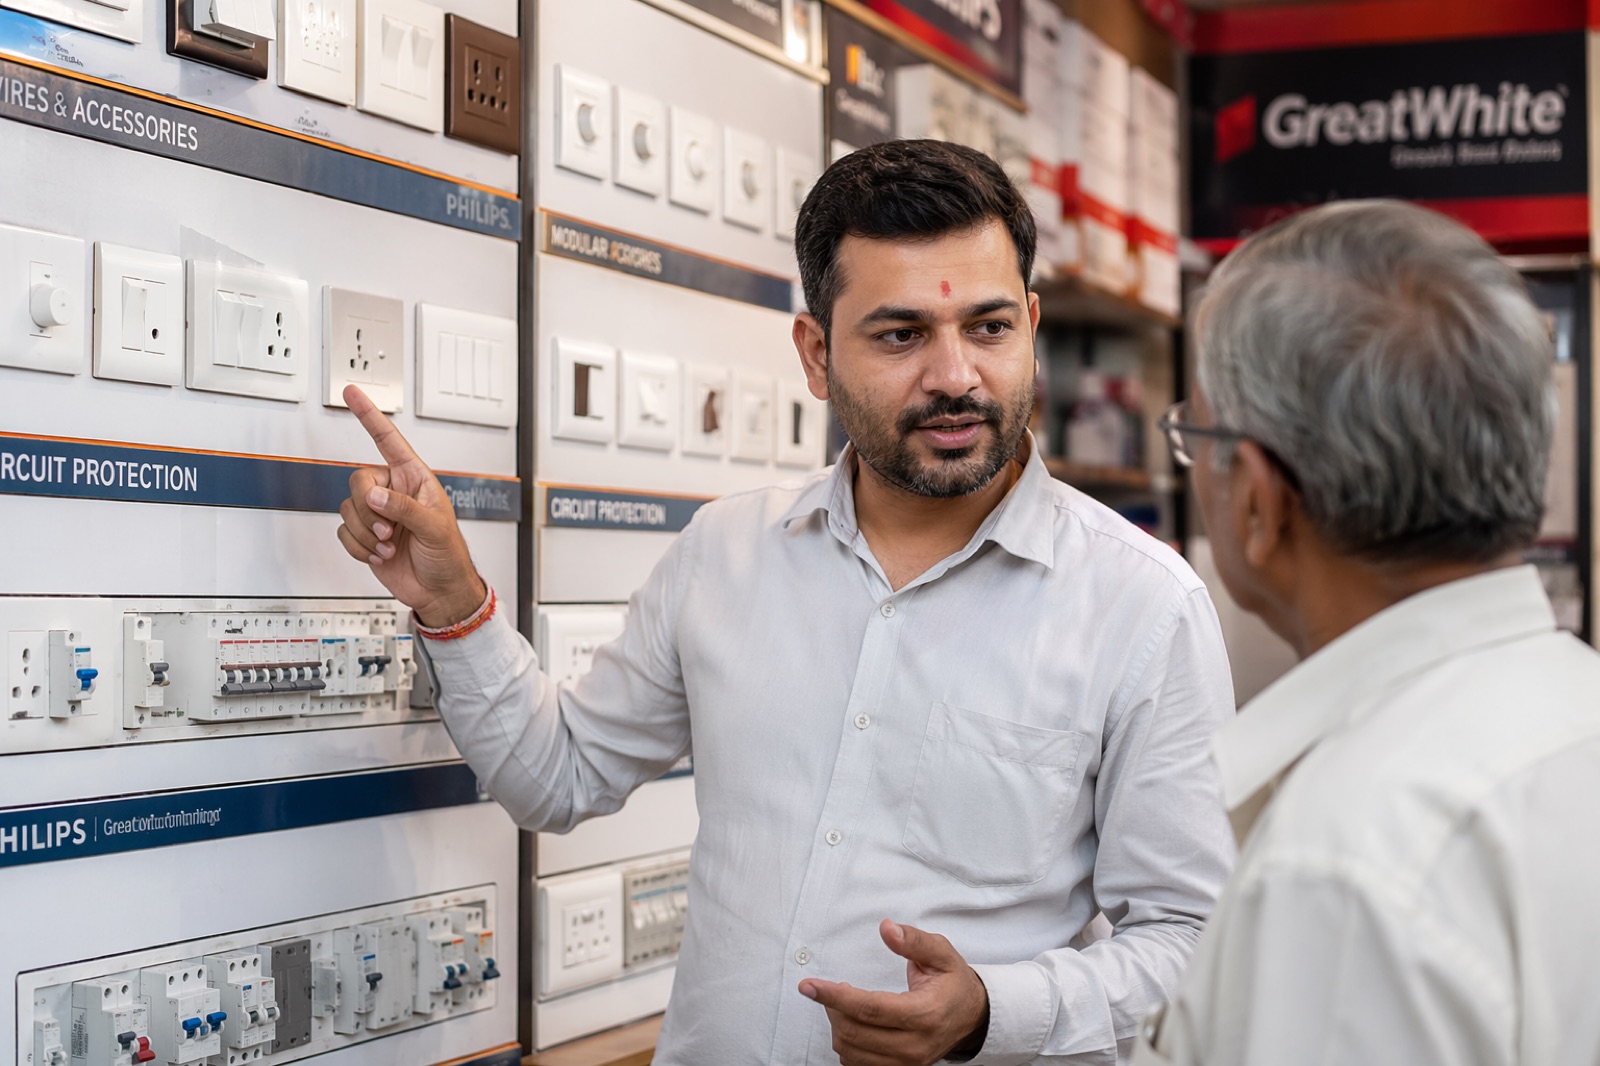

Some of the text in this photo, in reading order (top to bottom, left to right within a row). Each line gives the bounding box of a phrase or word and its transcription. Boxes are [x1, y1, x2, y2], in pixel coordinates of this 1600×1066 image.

[0, 76, 199, 151] IRES & ACCESSORIES
[1262, 80, 1566, 149] GreatWhite
[73, 457, 198, 492] PROTECTION
